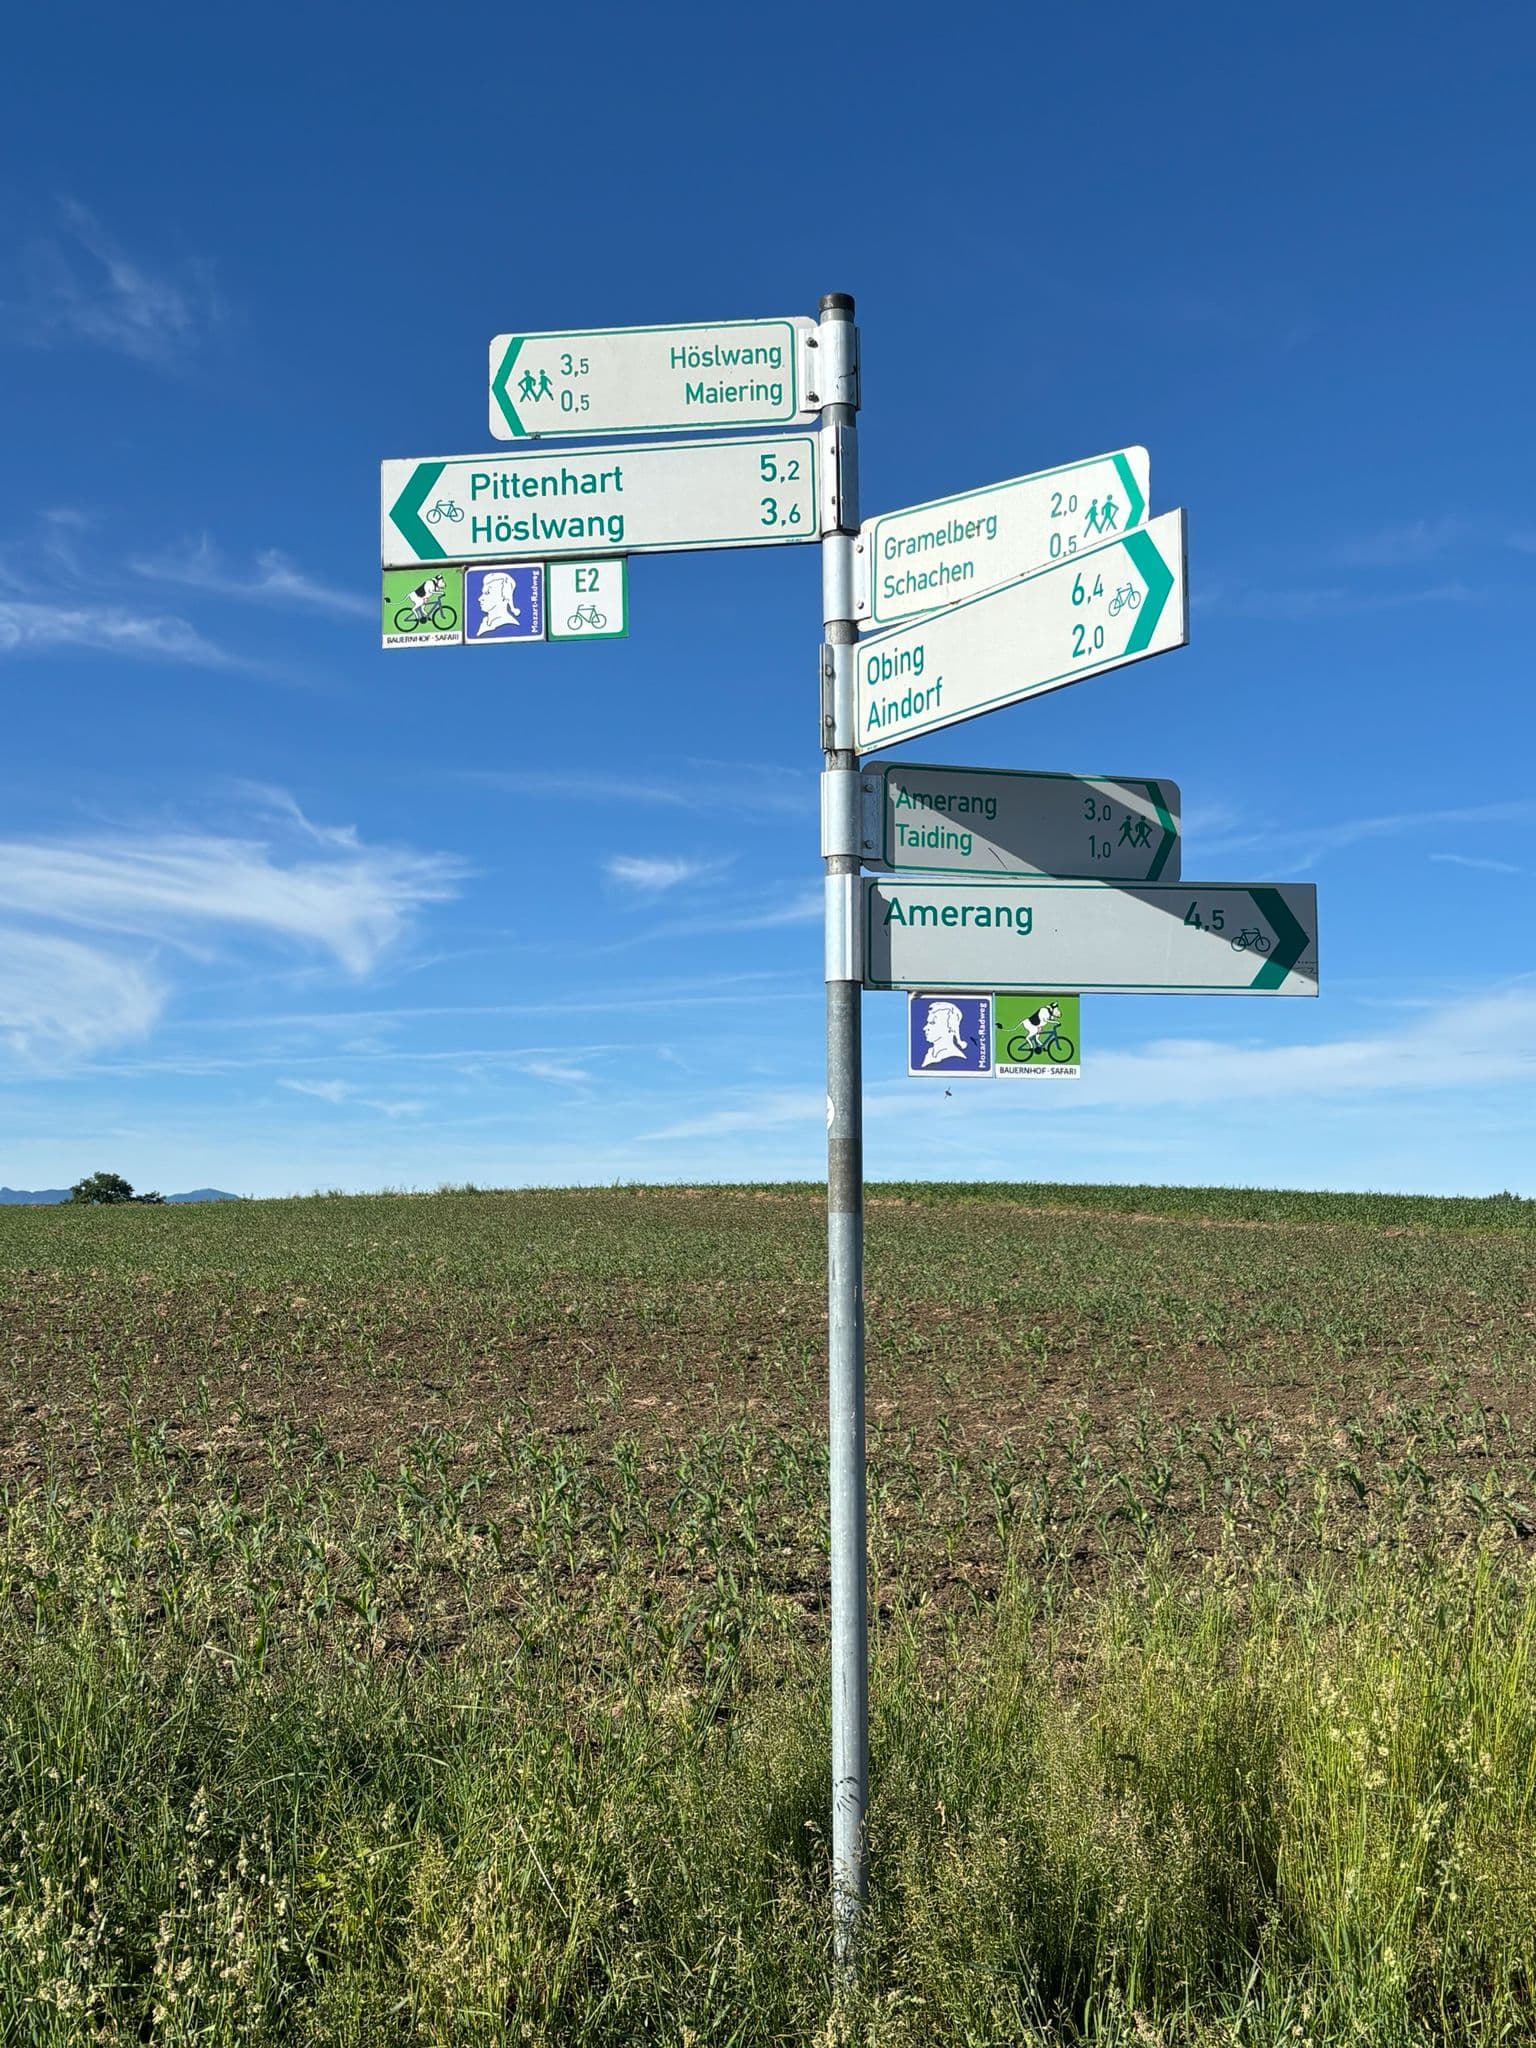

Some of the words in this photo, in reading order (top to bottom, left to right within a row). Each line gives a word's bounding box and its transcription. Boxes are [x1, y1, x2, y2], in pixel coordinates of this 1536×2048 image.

[560, 354, 590, 378] 3,5
[670, 345, 783, 371] Höslwang
[560, 390, 590, 413] 0,5
[685, 380, 783, 406] Maiering
[470, 466, 624, 501] Pittenhart
[760, 454, 801, 484] 5,2
[471, 512, 625, 544] Höslwang
[760, 497, 802, 528] 3,6
[884, 515, 998, 560] Gramelberg
[1050, 492, 1078, 519] 2,0
[575, 568, 600, 592] E2
[883, 560, 975, 599] Schachen
[1049, 533, 1078, 558] 0,5
[1071, 572, 1105, 607] 6,4
[1071, 623, 1105, 659] 2,0
[866, 644, 925, 686] Obing
[866, 676, 943, 733] Aindorf
[895, 786, 998, 820] Amerang
[1083, 798, 1112, 822] 3,0
[895, 823, 973, 856] Taiding
[1088, 835, 1112, 859] 1,0
[883, 897, 1034, 936] Amerang
[1183, 901, 1226, 932] 4,5
[977, 1002, 988, 1069] Mozart-Radweg
